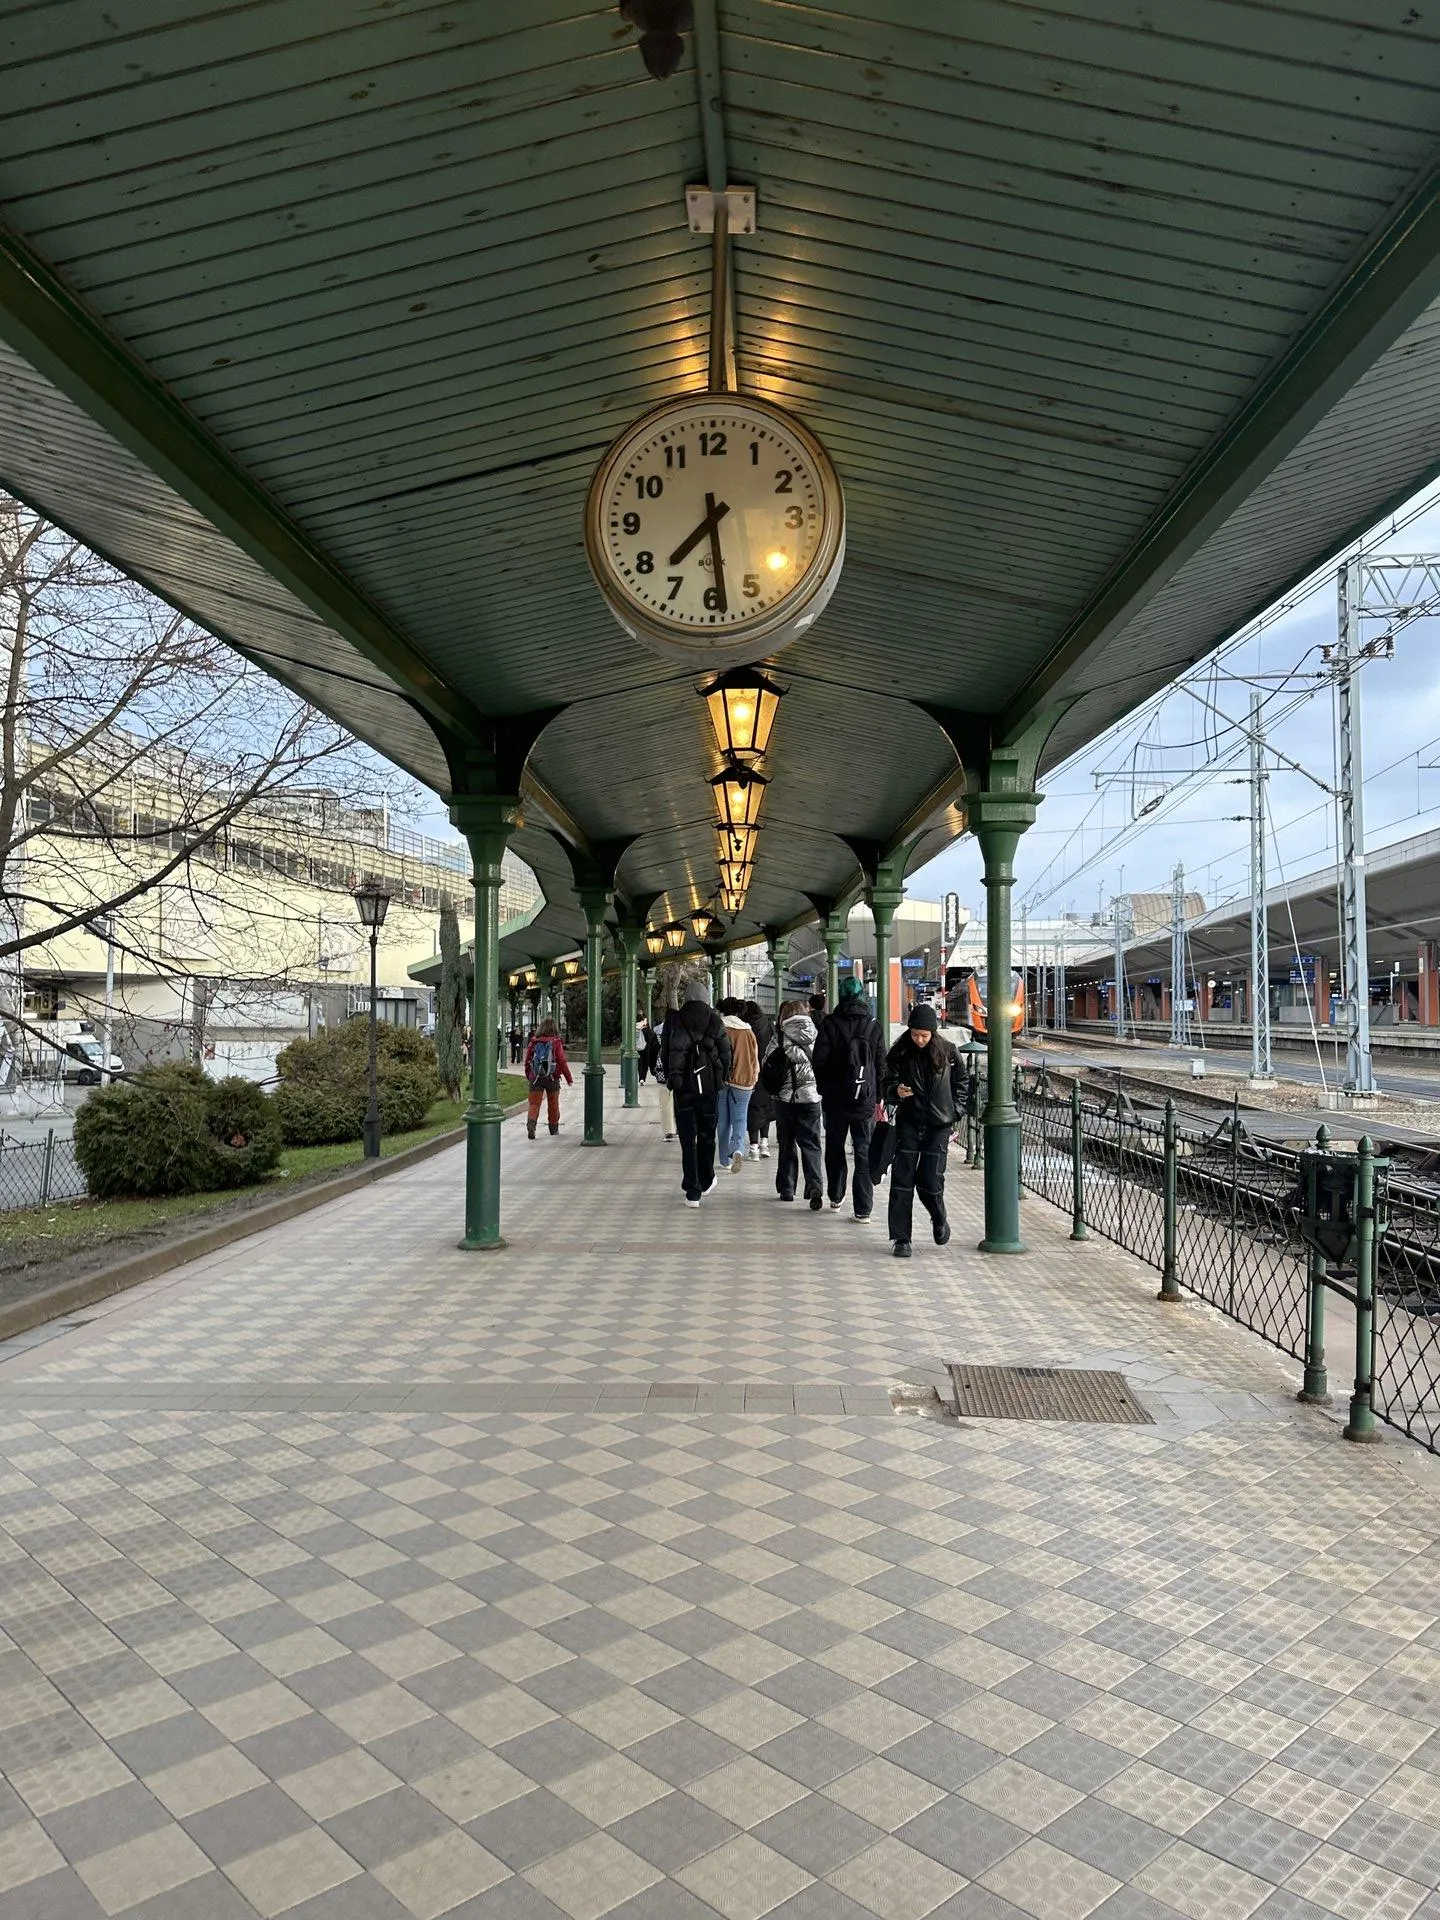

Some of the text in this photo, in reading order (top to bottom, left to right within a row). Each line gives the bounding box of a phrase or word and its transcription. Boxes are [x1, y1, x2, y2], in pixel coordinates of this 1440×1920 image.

[663, 444, 686, 469] 11
[699, 432, 728, 456] 12
[750, 441, 759, 466] 1
[635, 475, 664, 500] 10
[774, 469, 793, 494] 2
[623, 511, 641, 536] 9
[785, 505, 804, 530] 3
[635, 550, 655, 575] 8
[666, 576, 684, 601] 7
[742, 573, 761, 598] 5
[703, 586, 720, 611] 6
